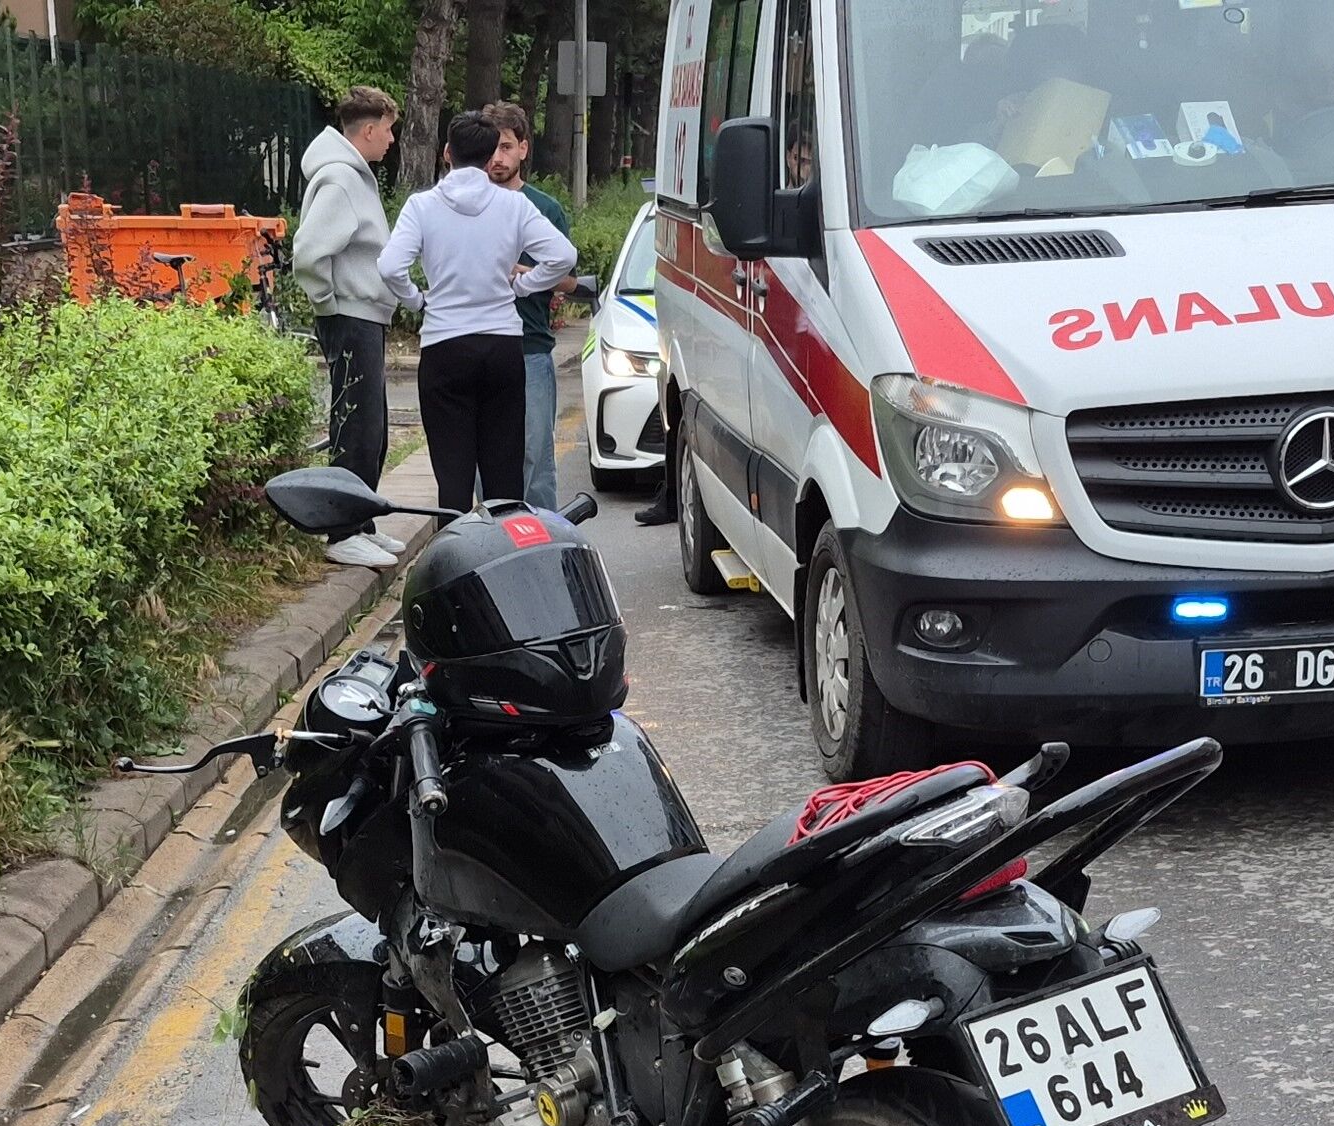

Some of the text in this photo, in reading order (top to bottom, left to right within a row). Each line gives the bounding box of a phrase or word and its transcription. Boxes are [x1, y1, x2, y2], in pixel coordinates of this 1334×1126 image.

[1206, 677, 1221, 687] TR
[1223, 653, 1264, 691] 26
[1295, 650, 1334, 687] DG
[1047, 1050, 1143, 1122] 644
